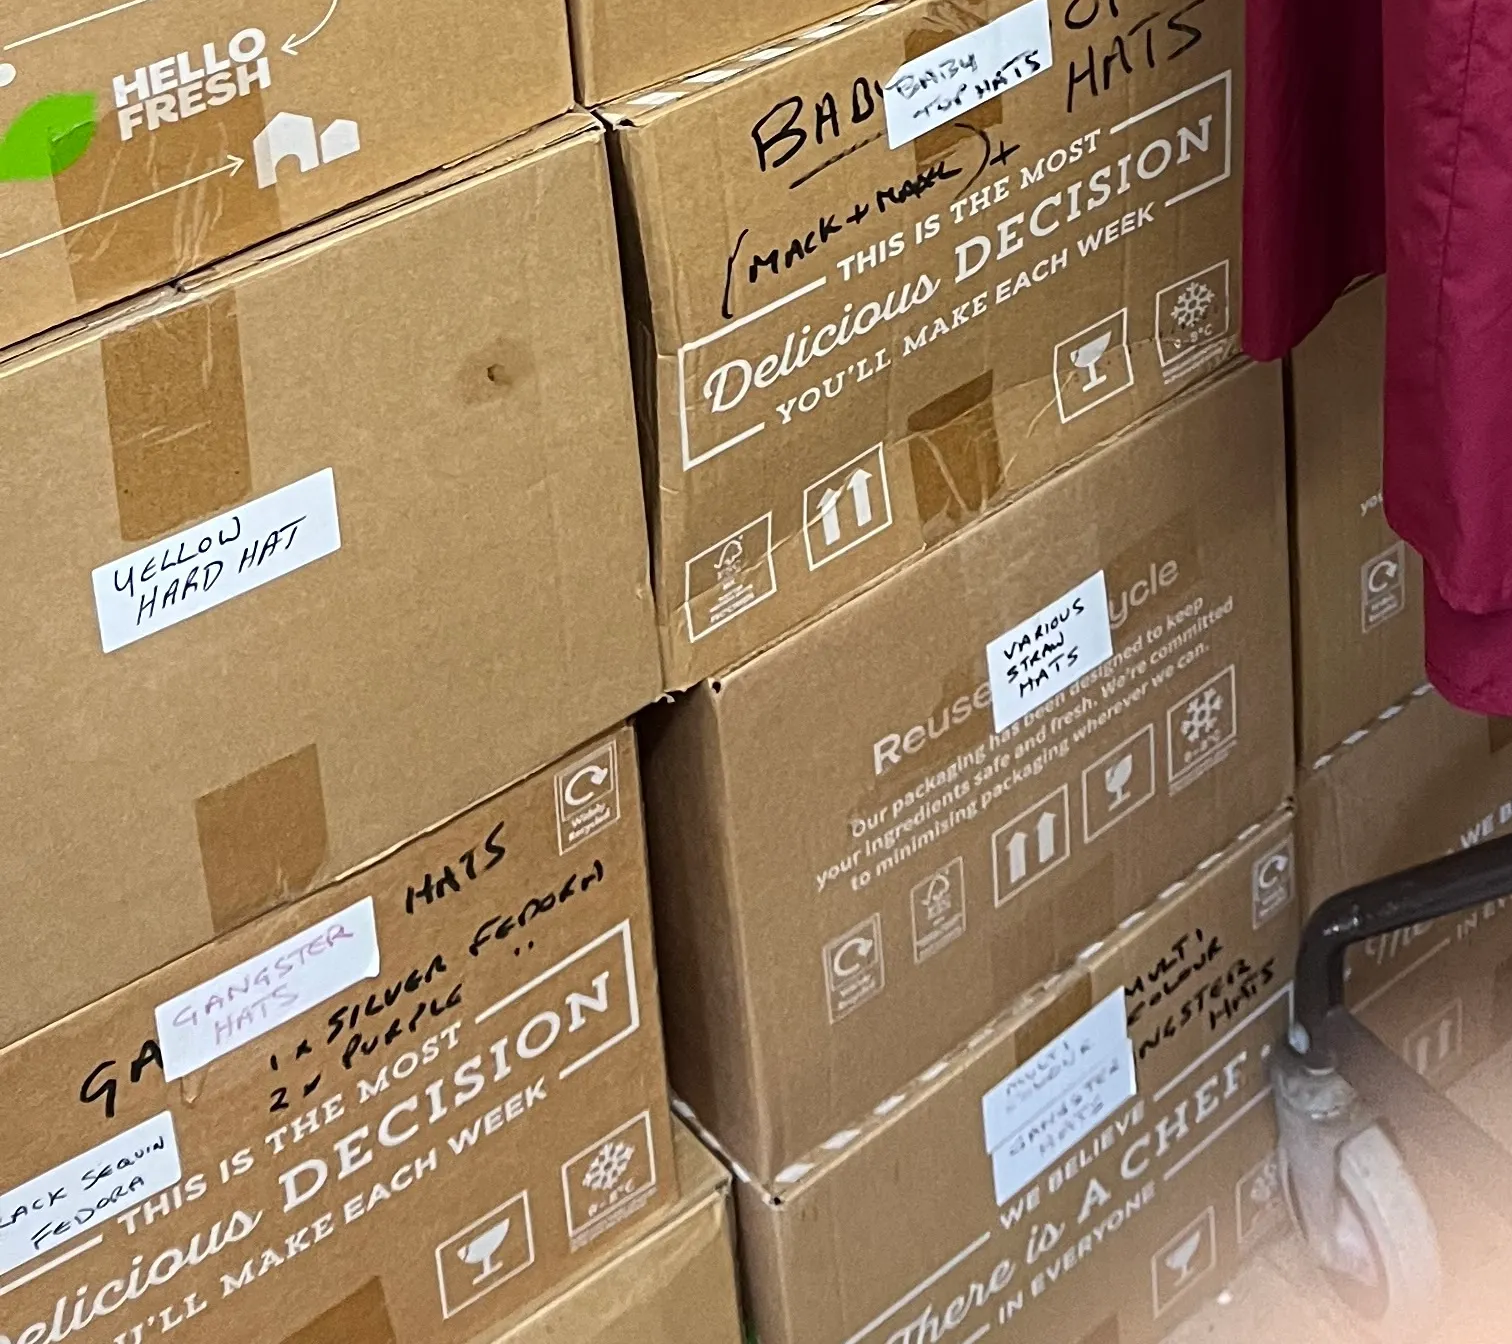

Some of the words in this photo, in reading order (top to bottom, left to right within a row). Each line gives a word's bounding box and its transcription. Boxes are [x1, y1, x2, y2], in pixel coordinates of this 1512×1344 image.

[113, 27, 265, 109] HELLO
[118, 57, 271, 141] FRESH
[838, 233, 905, 281] THIS
[915, 216, 941, 246] IS
[949, 180, 1010, 223] THE
[1020, 129, 1101, 189] MOST
[704, 273, 940, 413] Delicious
[955, 114, 1213, 283] DECISION
[776, 347, 892, 424] YOU'LL
[902, 292, 989, 357] MAKE
[995, 248, 1068, 304] EACH
[1076, 203, 1156, 257] WEEK
[114, 516, 241, 597] YELLOW
[136, 560, 224, 625] HARD
[238, 515, 307, 574] HAT
[1004, 598, 1085, 660] VARIOUS
[1007, 632, 1064, 683] STRAW
[1019, 647, 1078, 698] HATS
[816, 848, 861, 892] your
[866, 779, 970, 856] ingredients
[974, 753, 1010, 786] safe
[1014, 731, 1046, 759] and
[1050, 696, 1098, 739] fresh.
[1150, 596, 1234, 665] committed
[851, 806, 887, 837] Our
[893, 743, 986, 818] packaging
[989, 722, 1020, 751] has
[1069, 635, 1144, 696] designed
[1147, 626, 1163, 643] to
[1166, 598, 1203, 631] keep
[851, 872, 870, 891] to
[875, 800, 977, 876] minimising
[981, 737, 1070, 810] packaging
[1072, 682, 1148, 742] wherever
[1152, 662, 1174, 687] we
[1177, 643, 1210, 669] can.
[873, 681, 993, 775] Reuse
[405, 821, 506, 914] HATS
[172, 925, 354, 1028] GANGSTER
[214, 983, 298, 1046] HATS
[327, 954, 447, 1044] SILVER
[117, 1174, 208, 1235] THIS
[219, 1148, 254, 1183] IS
[265, 1093, 345, 1154] THE
[357, 1021, 462, 1103] MOST
[278, 971, 609, 1212] DECISION
[31, 1176, 145, 1249] FEDORA
[219, 1213, 334, 1299] MAKE
[344, 1148, 438, 1223] EACH
[448, 1076, 547, 1155] WEEK
[883, 1255, 1014, 1344] There
[1026, 1222, 1065, 1264] is
[1078, 1177, 1111, 1225] A
[1121, 1051, 1247, 1180] CHEF
[1000, 1187, 1039, 1230] WE
[1048, 1101, 1145, 1194] BELIEVE
[999, 1291, 1023, 1324] IN
[1031, 1182, 1156, 1297] EVERYONE
